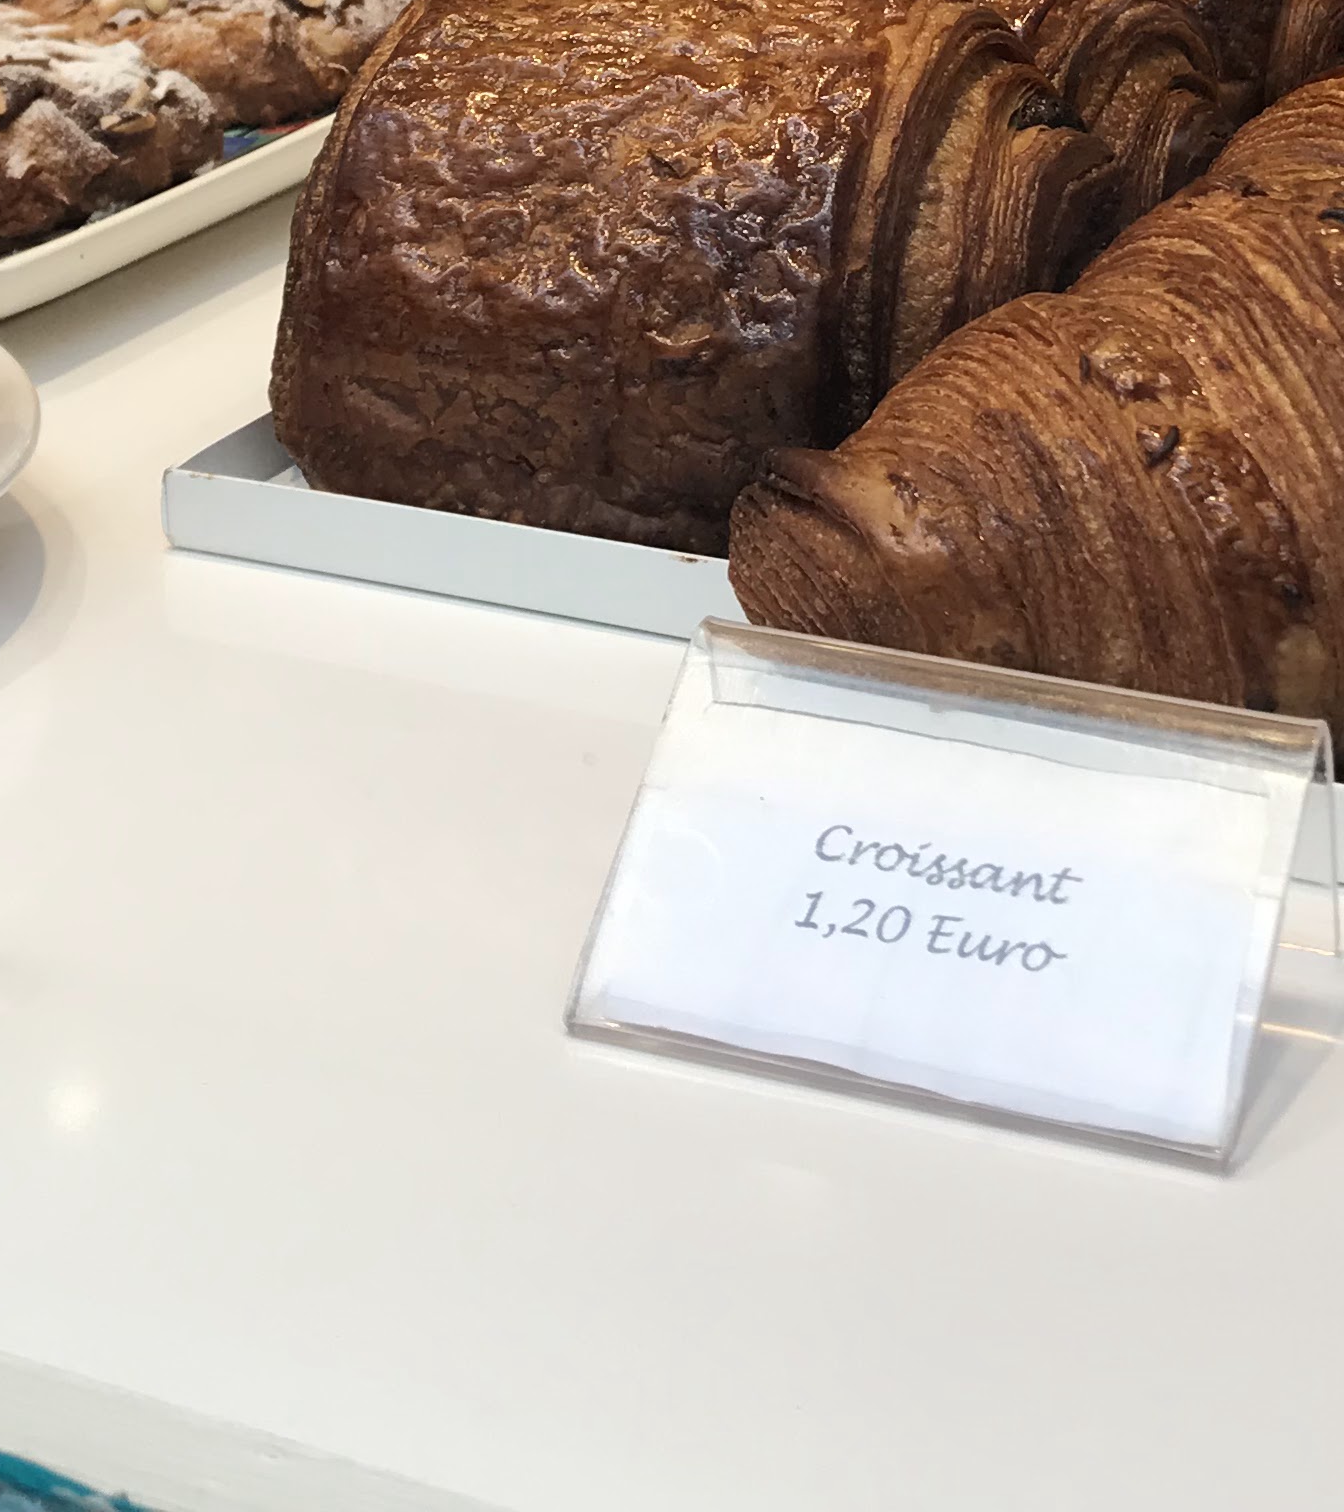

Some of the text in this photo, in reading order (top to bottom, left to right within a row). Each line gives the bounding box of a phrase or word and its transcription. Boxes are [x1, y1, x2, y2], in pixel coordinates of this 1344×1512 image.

[814, 824, 1084, 905] Croissant
[794, 890, 1068, 973] 1,20 Euro
